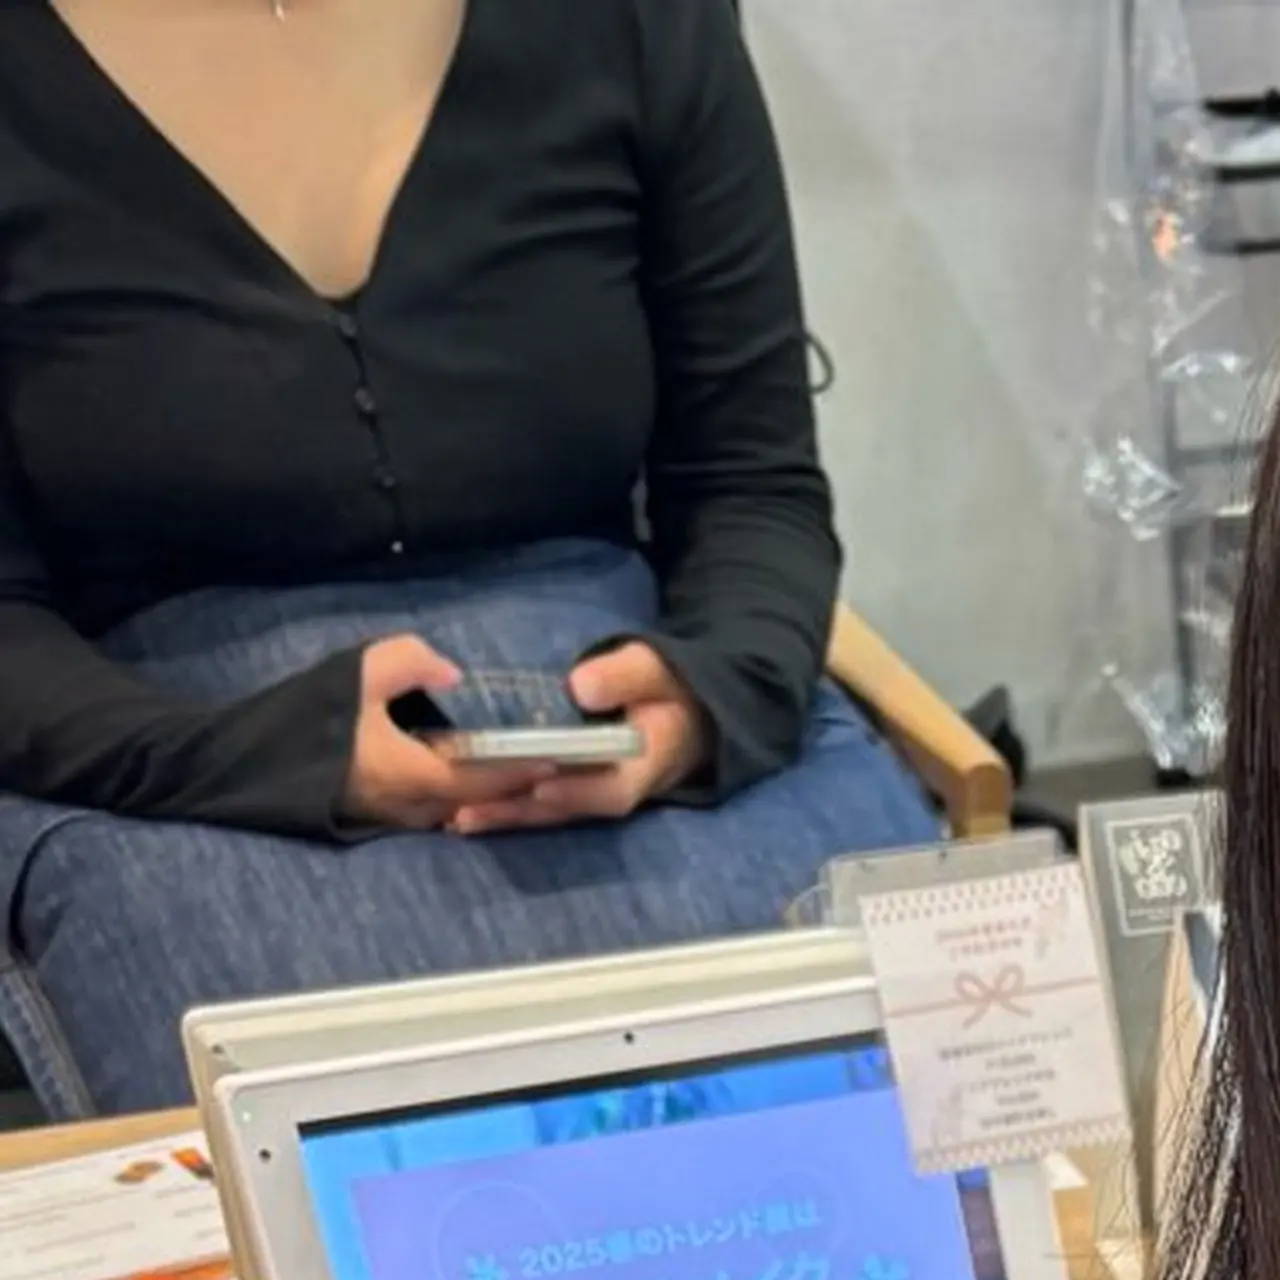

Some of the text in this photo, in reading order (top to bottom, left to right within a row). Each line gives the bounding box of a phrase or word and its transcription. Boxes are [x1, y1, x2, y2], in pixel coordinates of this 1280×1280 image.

[519, 1200, 822, 1278] 2025のトレンドは
